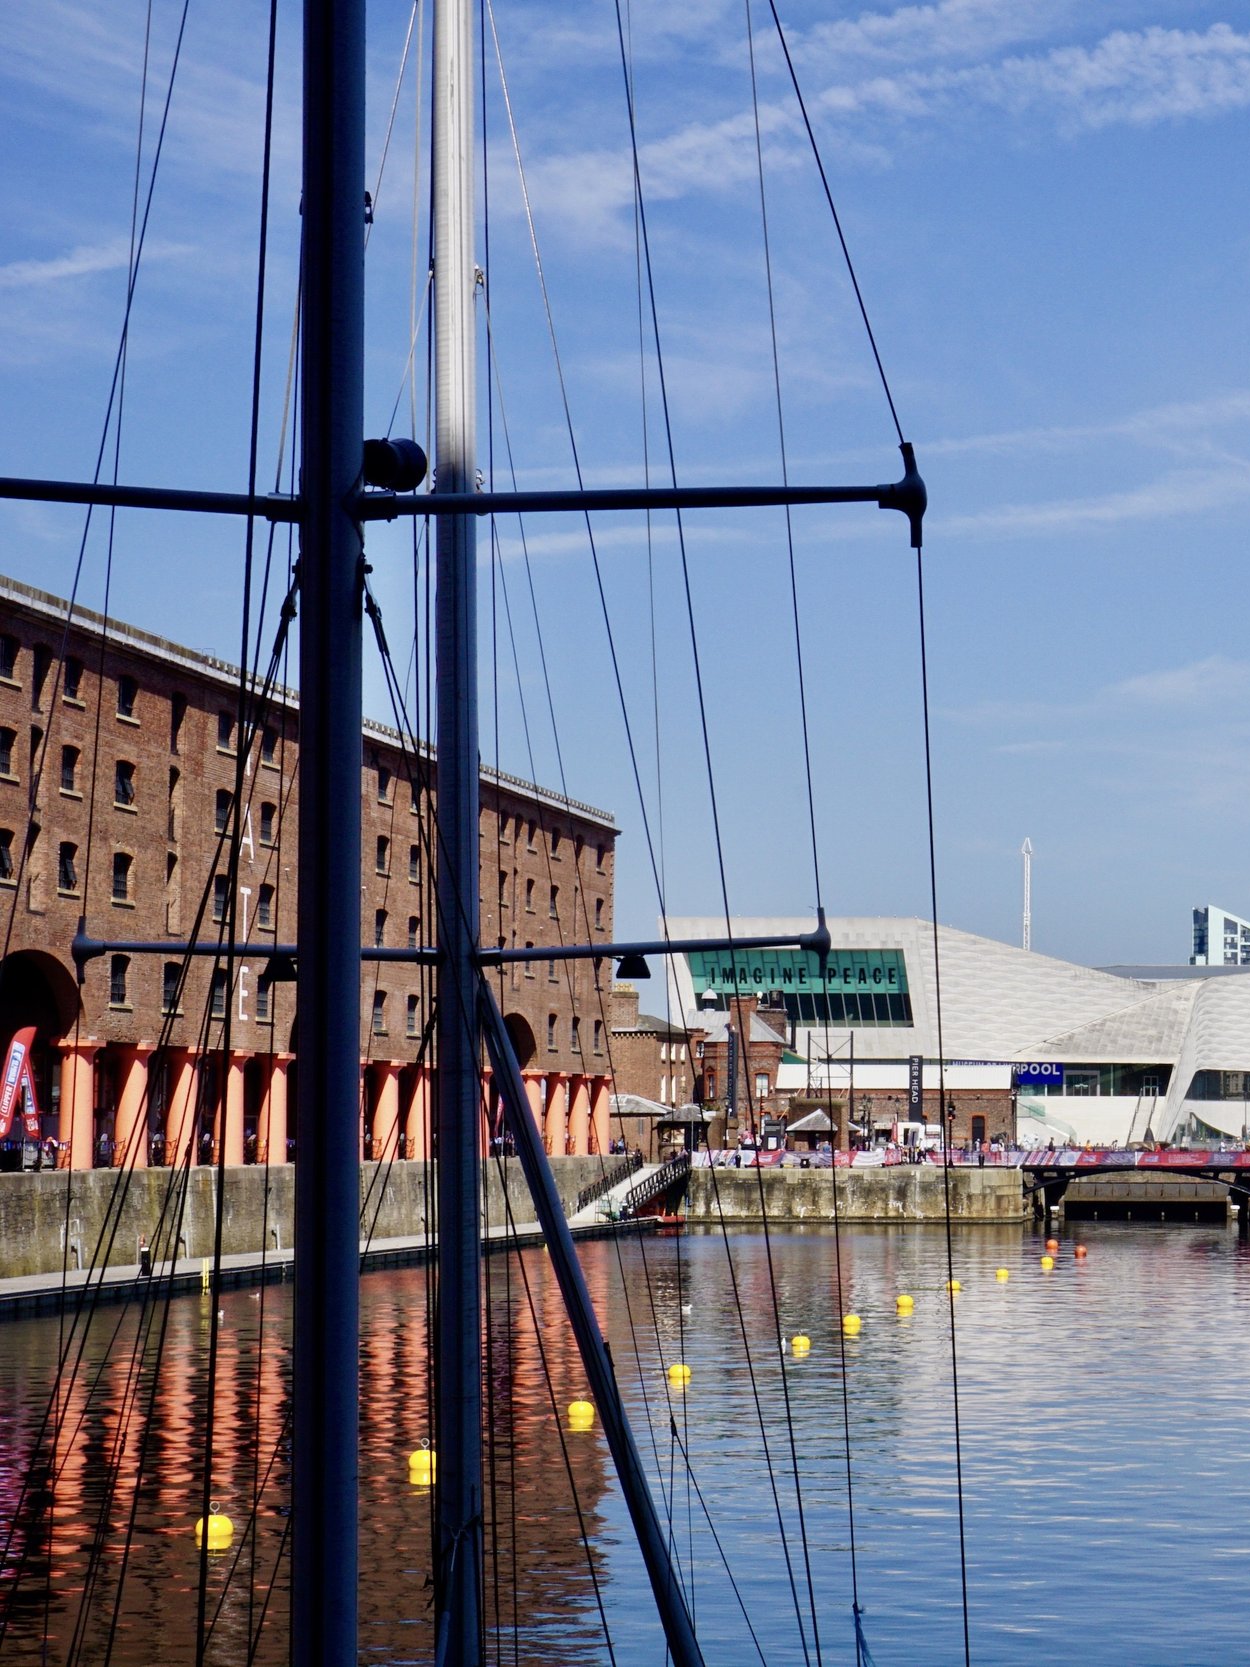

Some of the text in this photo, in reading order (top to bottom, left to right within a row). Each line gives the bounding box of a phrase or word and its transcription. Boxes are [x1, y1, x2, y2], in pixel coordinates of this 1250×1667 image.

[710, 967, 897, 985] IMAGINE PEACE
[911, 1057, 919, 1104] PIER HEAD
